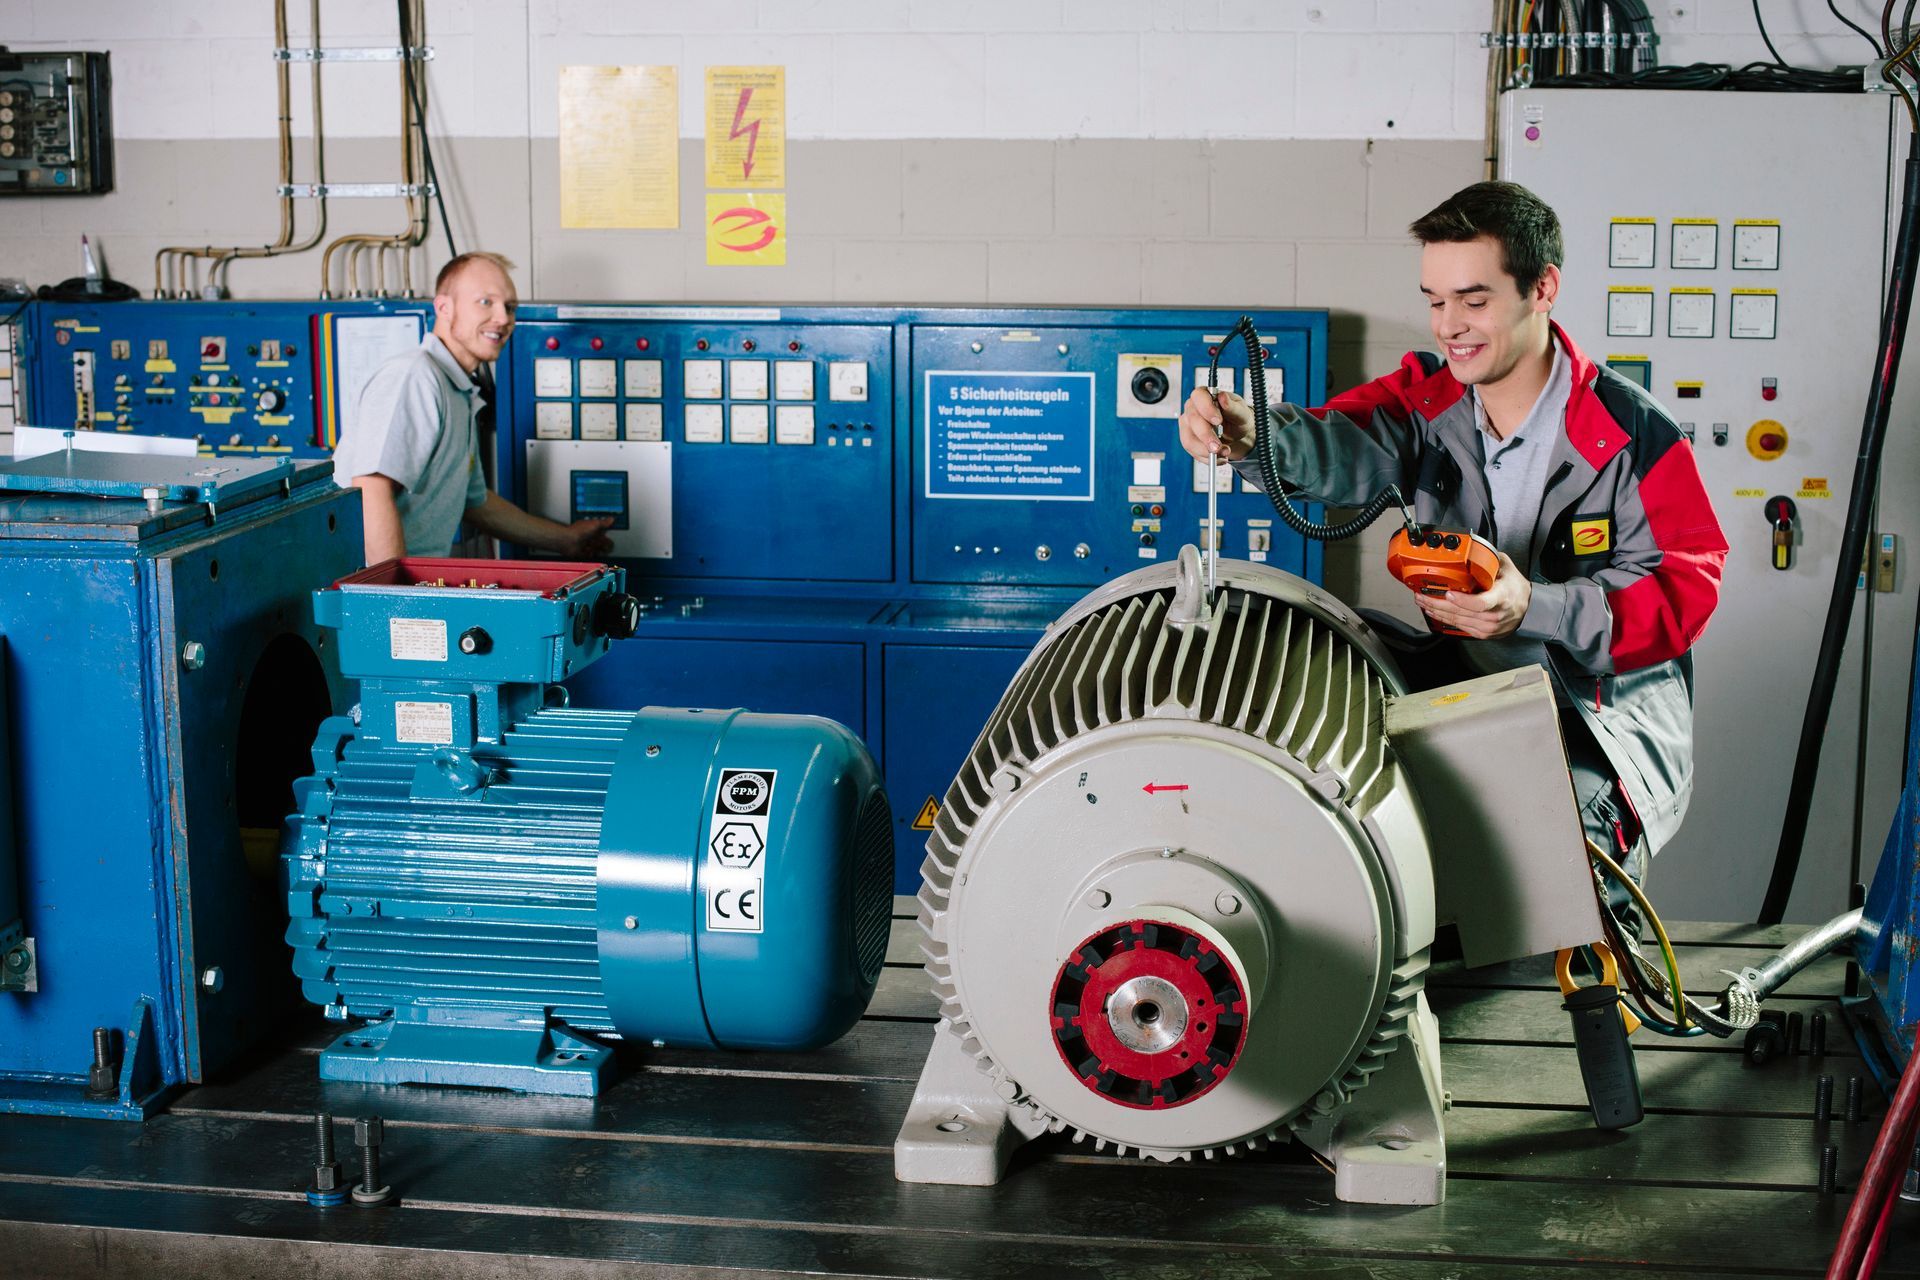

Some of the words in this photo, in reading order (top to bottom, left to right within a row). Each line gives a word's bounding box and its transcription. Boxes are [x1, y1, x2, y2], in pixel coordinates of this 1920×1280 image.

[950, 387, 959, 400] 5
[960, 387, 1070, 404] Sicherheitsregeln
[938, 405, 954, 417] Vor
[954, 406, 986, 418] Beginn
[987, 406, 1002, 417] der
[1003, 407, 1044, 417] Arbeiten:
[947, 420, 991, 429] Freischalten
[947, 431, 970, 441] Gegen
[971, 432, 1037, 441] Wiedereinschalten
[1037, 433, 1065, 441] sichern
[947, 442, 1010, 452] Spannungsfreiheit
[1011, 443, 1048, 452] feststellen
[947, 452, 968, 461] Erden
[968, 453, 982, 461] und
[983, 453, 1032, 462] kurzschließen
[994, 465, 1013, 473] unter
[1014, 464, 1049, 474] Spannung
[1049, 465, 1082, 474] stehende
[947, 474, 965, 483] Teile
[966, 474, 1000, 483] abdecken
[1001, 475, 1017, 484] oder
[1018, 475, 1063, 484] abschranken
[726, 774, 766, 790] FLAMEPROOF
[731, 787, 758, 796] FPM
[728, 802, 757, 811] MOTORS
[714, 888, 755, 919] CE
